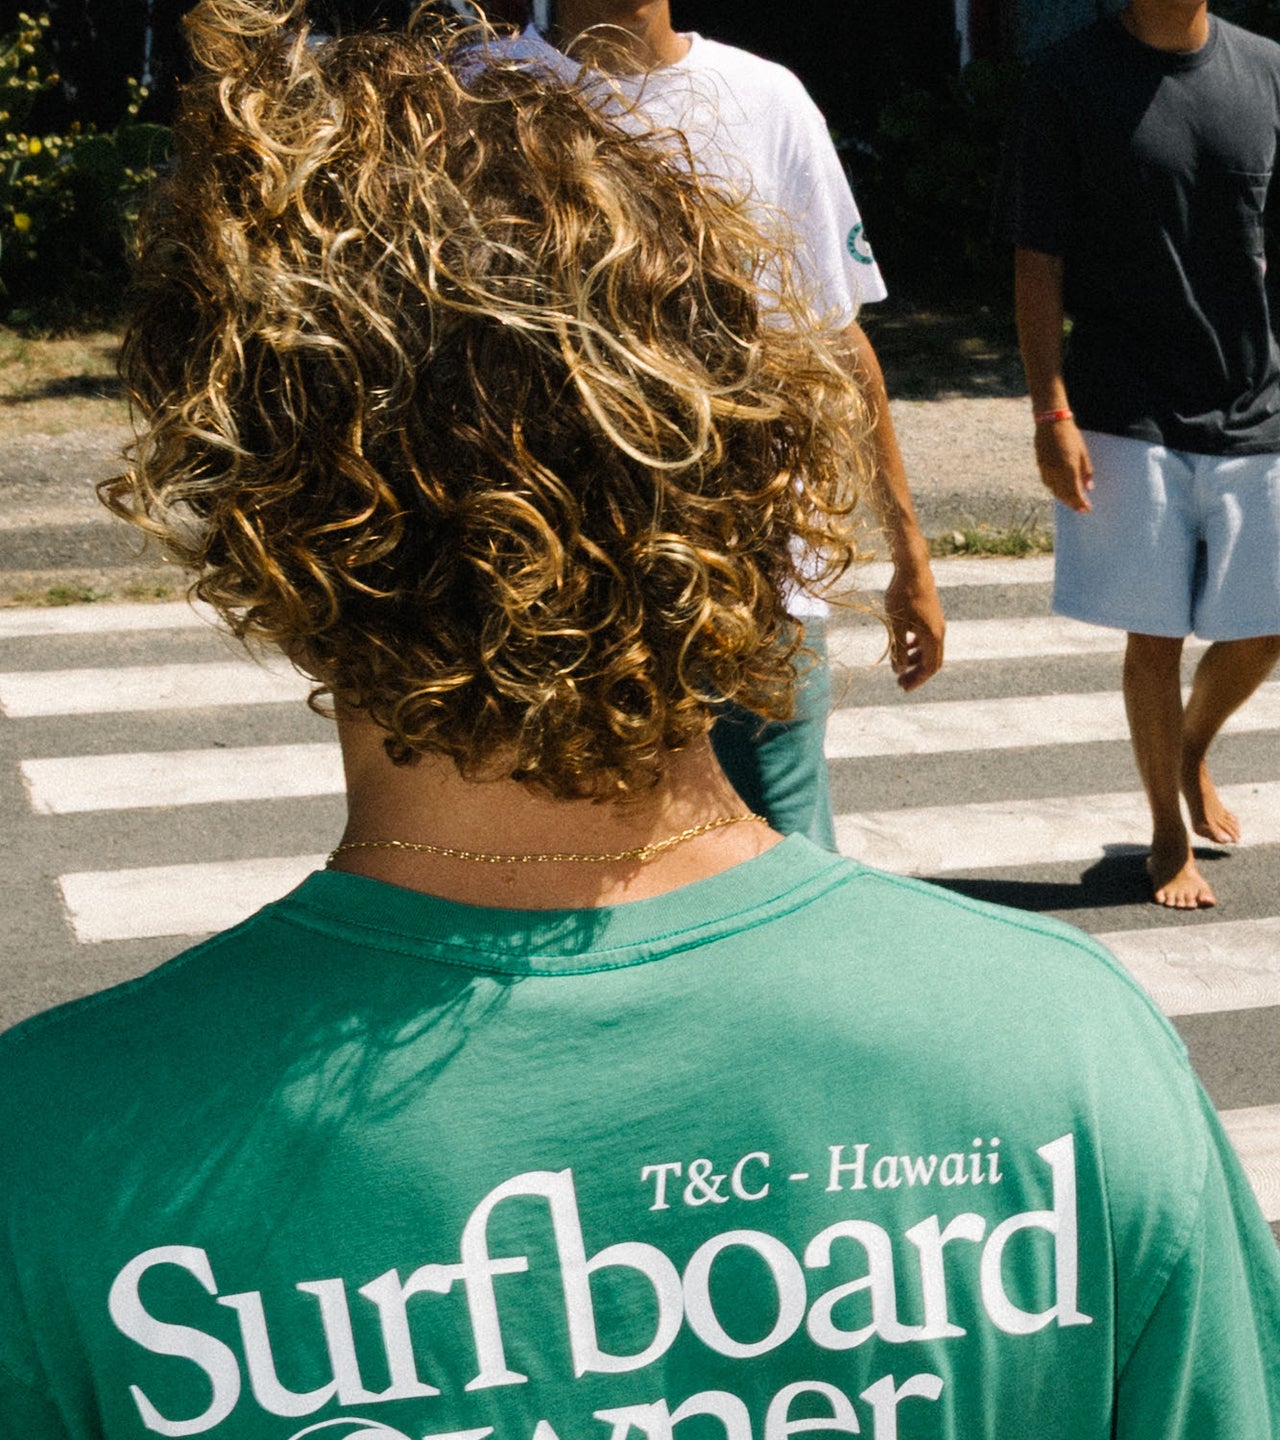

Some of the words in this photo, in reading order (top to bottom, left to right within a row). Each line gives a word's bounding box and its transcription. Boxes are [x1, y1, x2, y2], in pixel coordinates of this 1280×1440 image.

[640, 1150, 771, 1212] T&C
[824, 1136, 1003, 1192] Hawaii
[106, 1132, 1093, 1437] Surfboard
